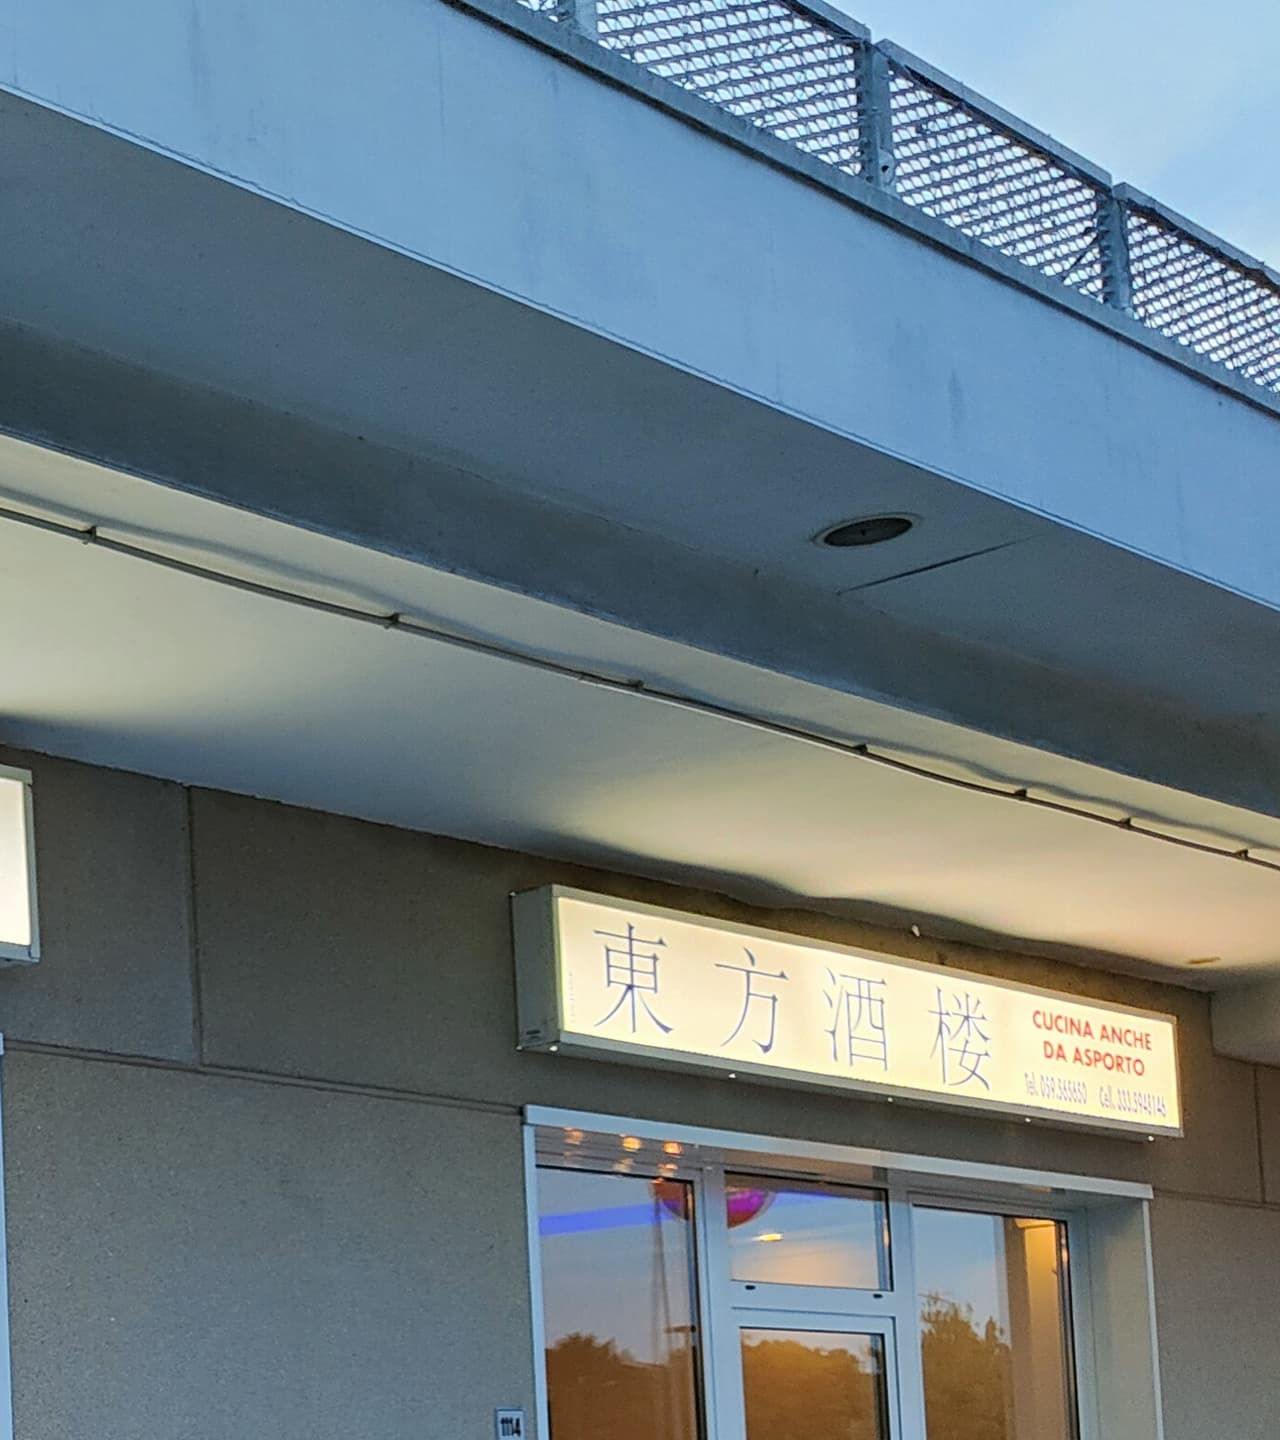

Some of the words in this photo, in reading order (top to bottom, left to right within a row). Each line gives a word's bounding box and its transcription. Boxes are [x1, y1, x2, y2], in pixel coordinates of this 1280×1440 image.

[593, 922, 992, 1091] 東方酒楼
[1032, 1010, 1095, 1039] CUCINA
[1100, 1024, 1152, 1051] ANCHE
[1043, 1040, 1068, 1062] DA
[1072, 1047, 1146, 1076] ASPORTO
